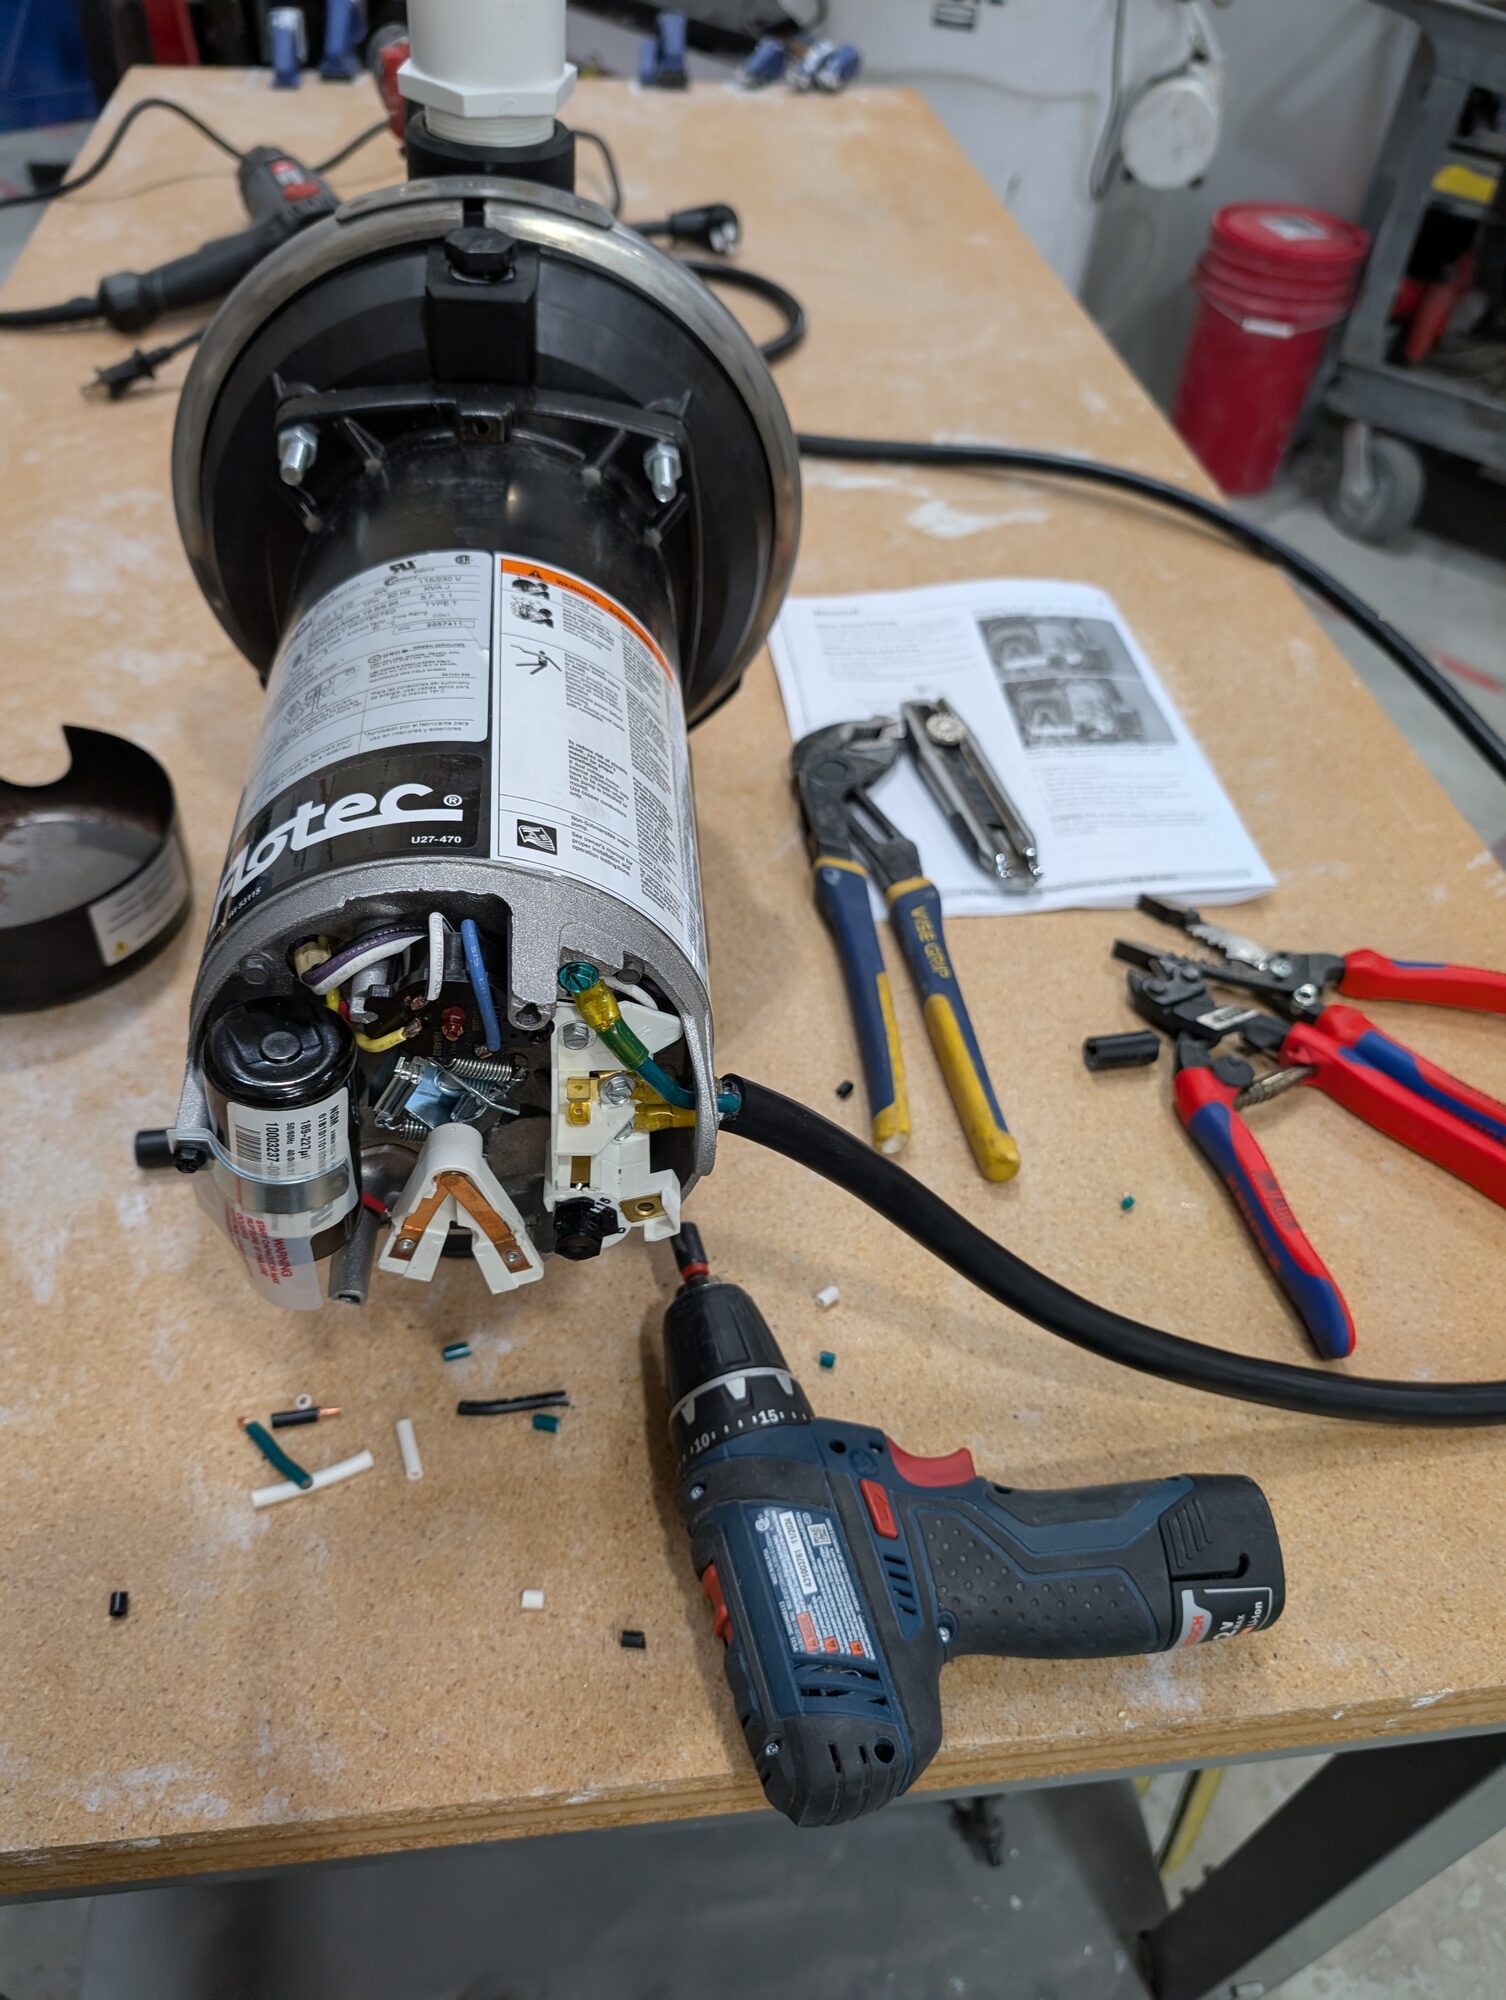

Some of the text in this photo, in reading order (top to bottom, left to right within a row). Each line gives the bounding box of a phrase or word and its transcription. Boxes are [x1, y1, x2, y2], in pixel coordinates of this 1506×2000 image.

[411, 835, 462, 844] U27-470
[330, 1104, 340, 1125] NGM
[286, 1122, 295, 1145] 50/60Hz
[590, 1197, 611, 1211] 115
[272, 1238, 293, 1277] WARNING
[694, 1408, 779, 1451] 10 15
[783, 1516, 798, 1544] 11/2024
[1248, 1601, 1263, 1626] Li-Ion
